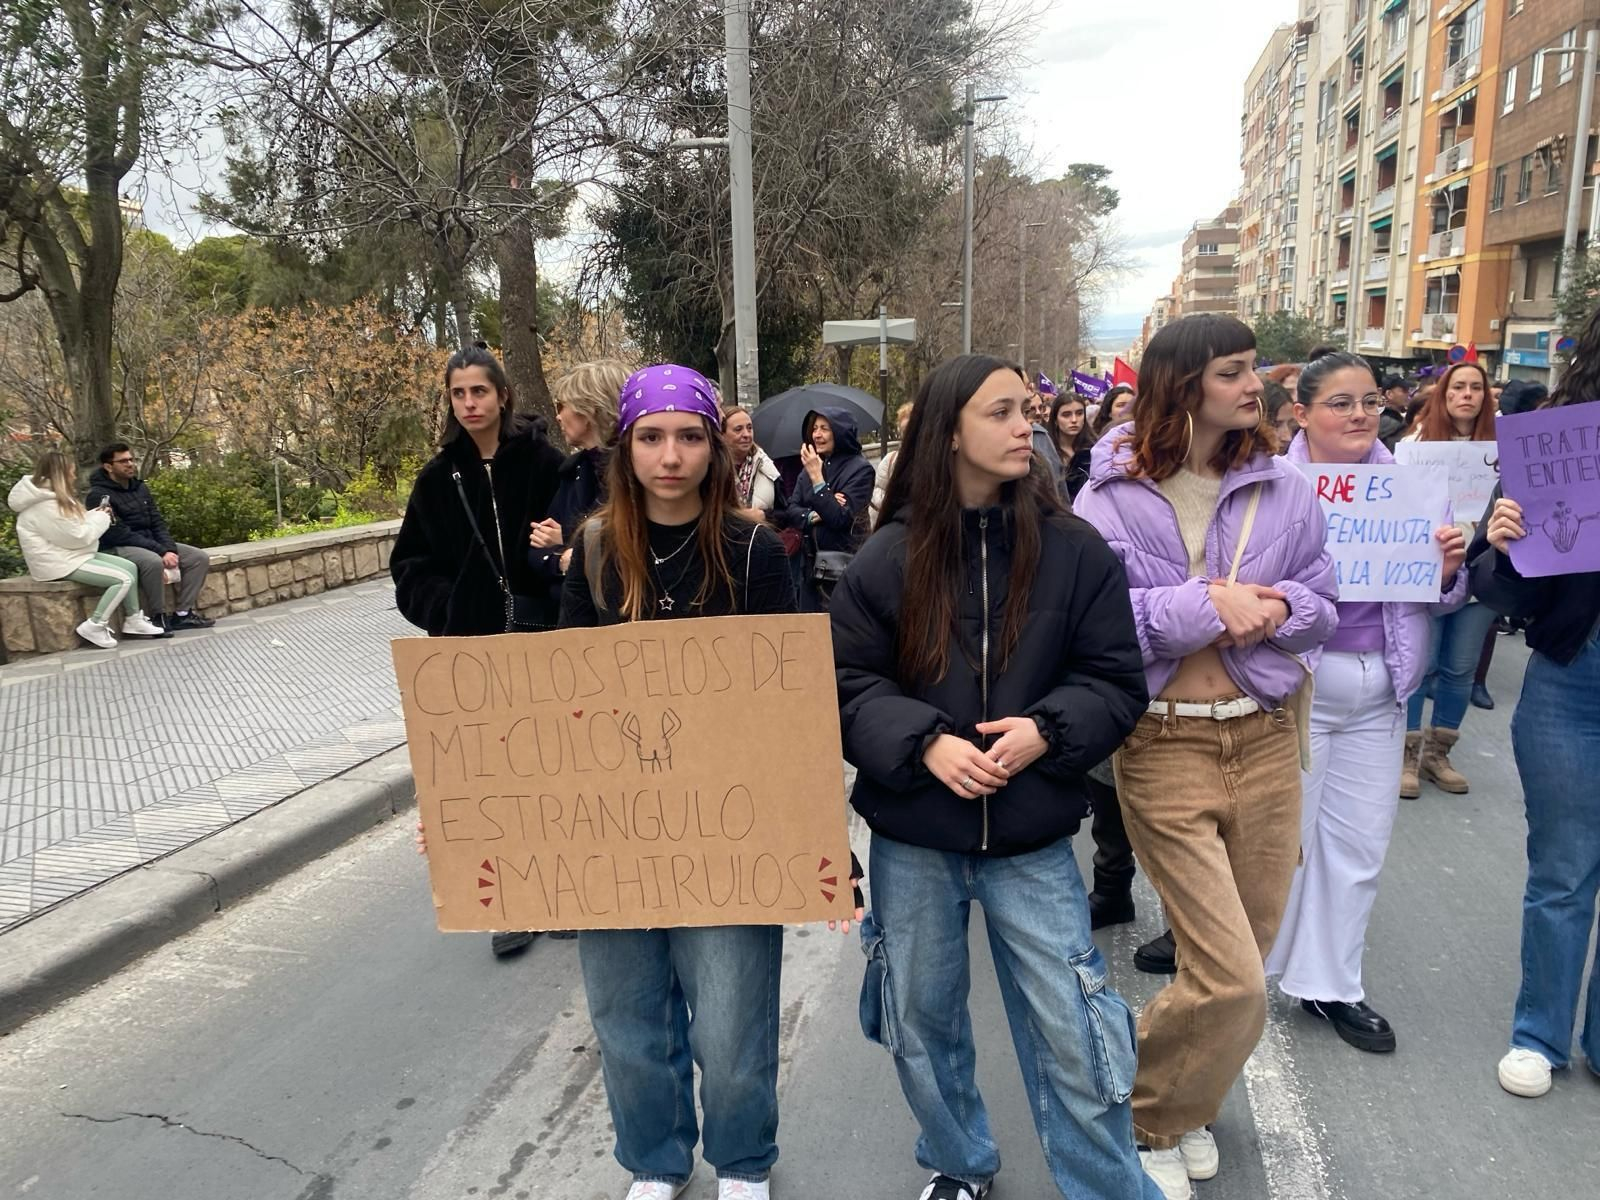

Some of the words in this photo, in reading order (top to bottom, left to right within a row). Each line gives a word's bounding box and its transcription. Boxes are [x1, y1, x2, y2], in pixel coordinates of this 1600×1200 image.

[1317, 474, 1356, 504] RAE
[1366, 475, 1394, 502] ES
[1327, 513, 1431, 545] FEMINISTA
[1349, 561, 1370, 586] LA
[1384, 561, 1438, 587] VISTA
[525, 647, 605, 703] LOS
[614, 636, 732, 697] PELOS
[752, 631, 806, 692] DE
[430, 722, 496, 787] MI
[506, 711, 626, 777] CULO
[439, 784, 755, 843] ESTRANGULO
[495, 853, 812, 921] MACHIRULOS
